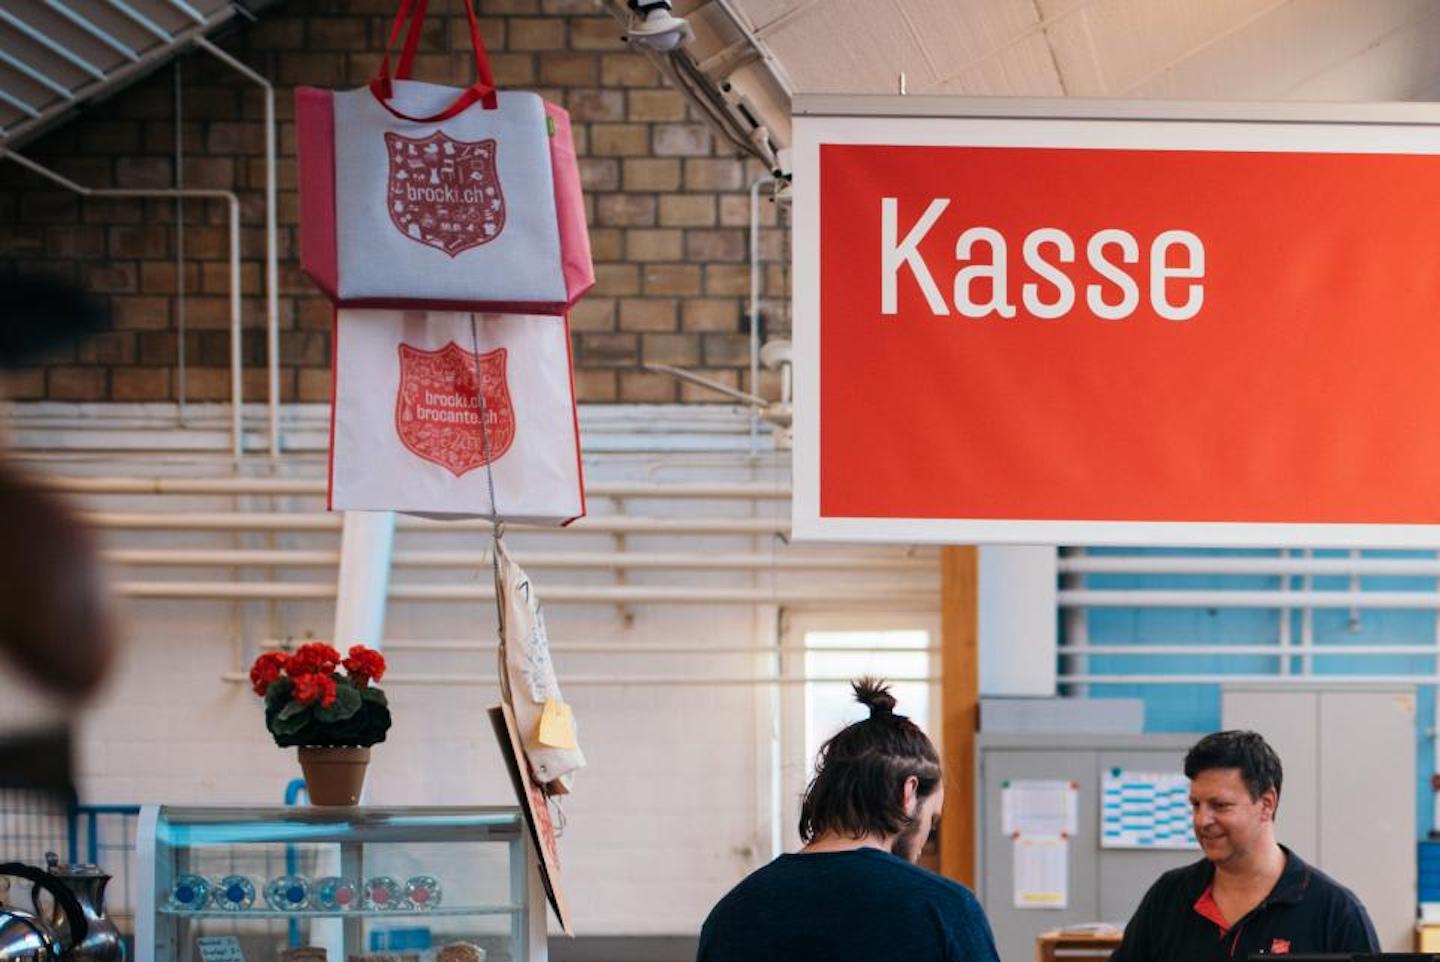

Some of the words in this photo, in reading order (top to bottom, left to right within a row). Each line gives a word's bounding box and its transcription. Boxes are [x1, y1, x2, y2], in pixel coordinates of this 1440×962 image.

[407, 183, 484, 203] brocki.ch
[881, 197, 1206, 320] Kasse
[425, 390, 487, 408] brocki.ch
[416, 404, 499, 424] brocante.ch
